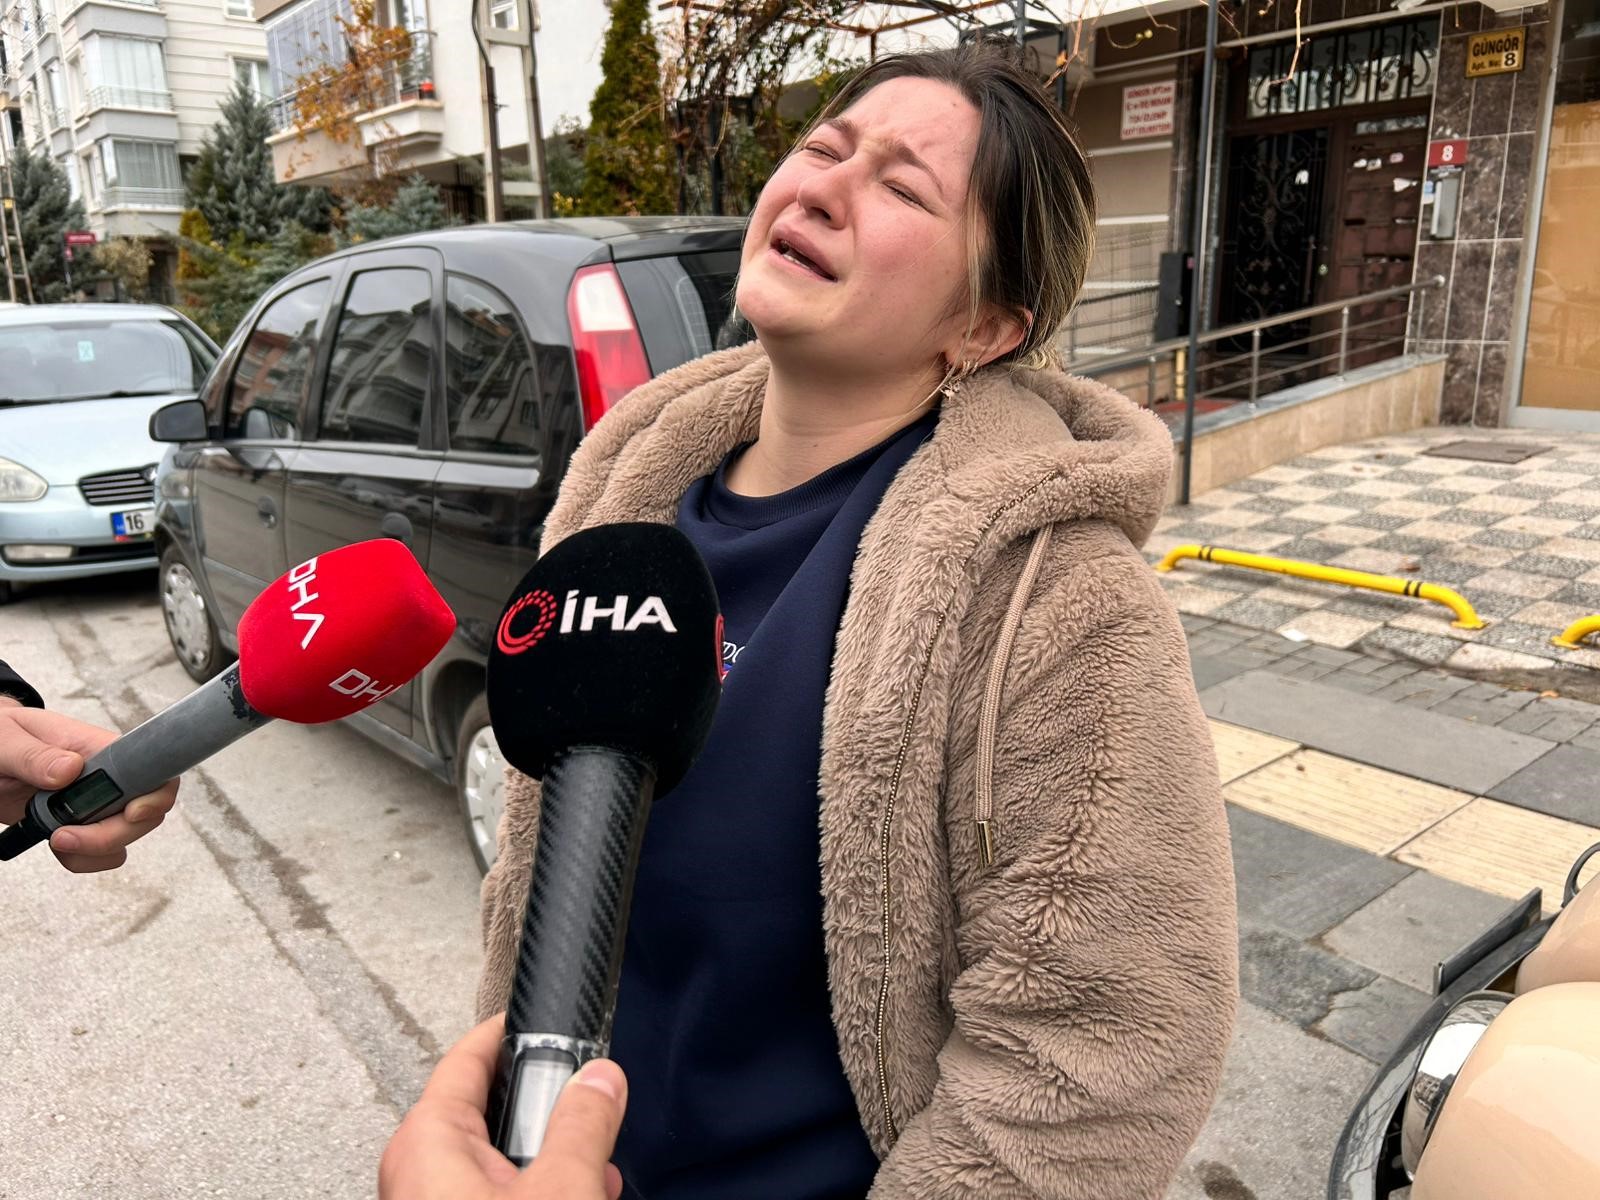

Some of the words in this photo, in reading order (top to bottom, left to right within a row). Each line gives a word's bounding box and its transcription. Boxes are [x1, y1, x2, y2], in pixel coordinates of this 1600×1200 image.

[1472, 34, 1519, 57] GÜNGÖR
[1504, 52, 1516, 67] 8
[1442, 144, 1454, 162] 8
[126, 514, 145, 531] 16
[559, 589, 678, 634] İHA
[328, 668, 404, 703] DH
